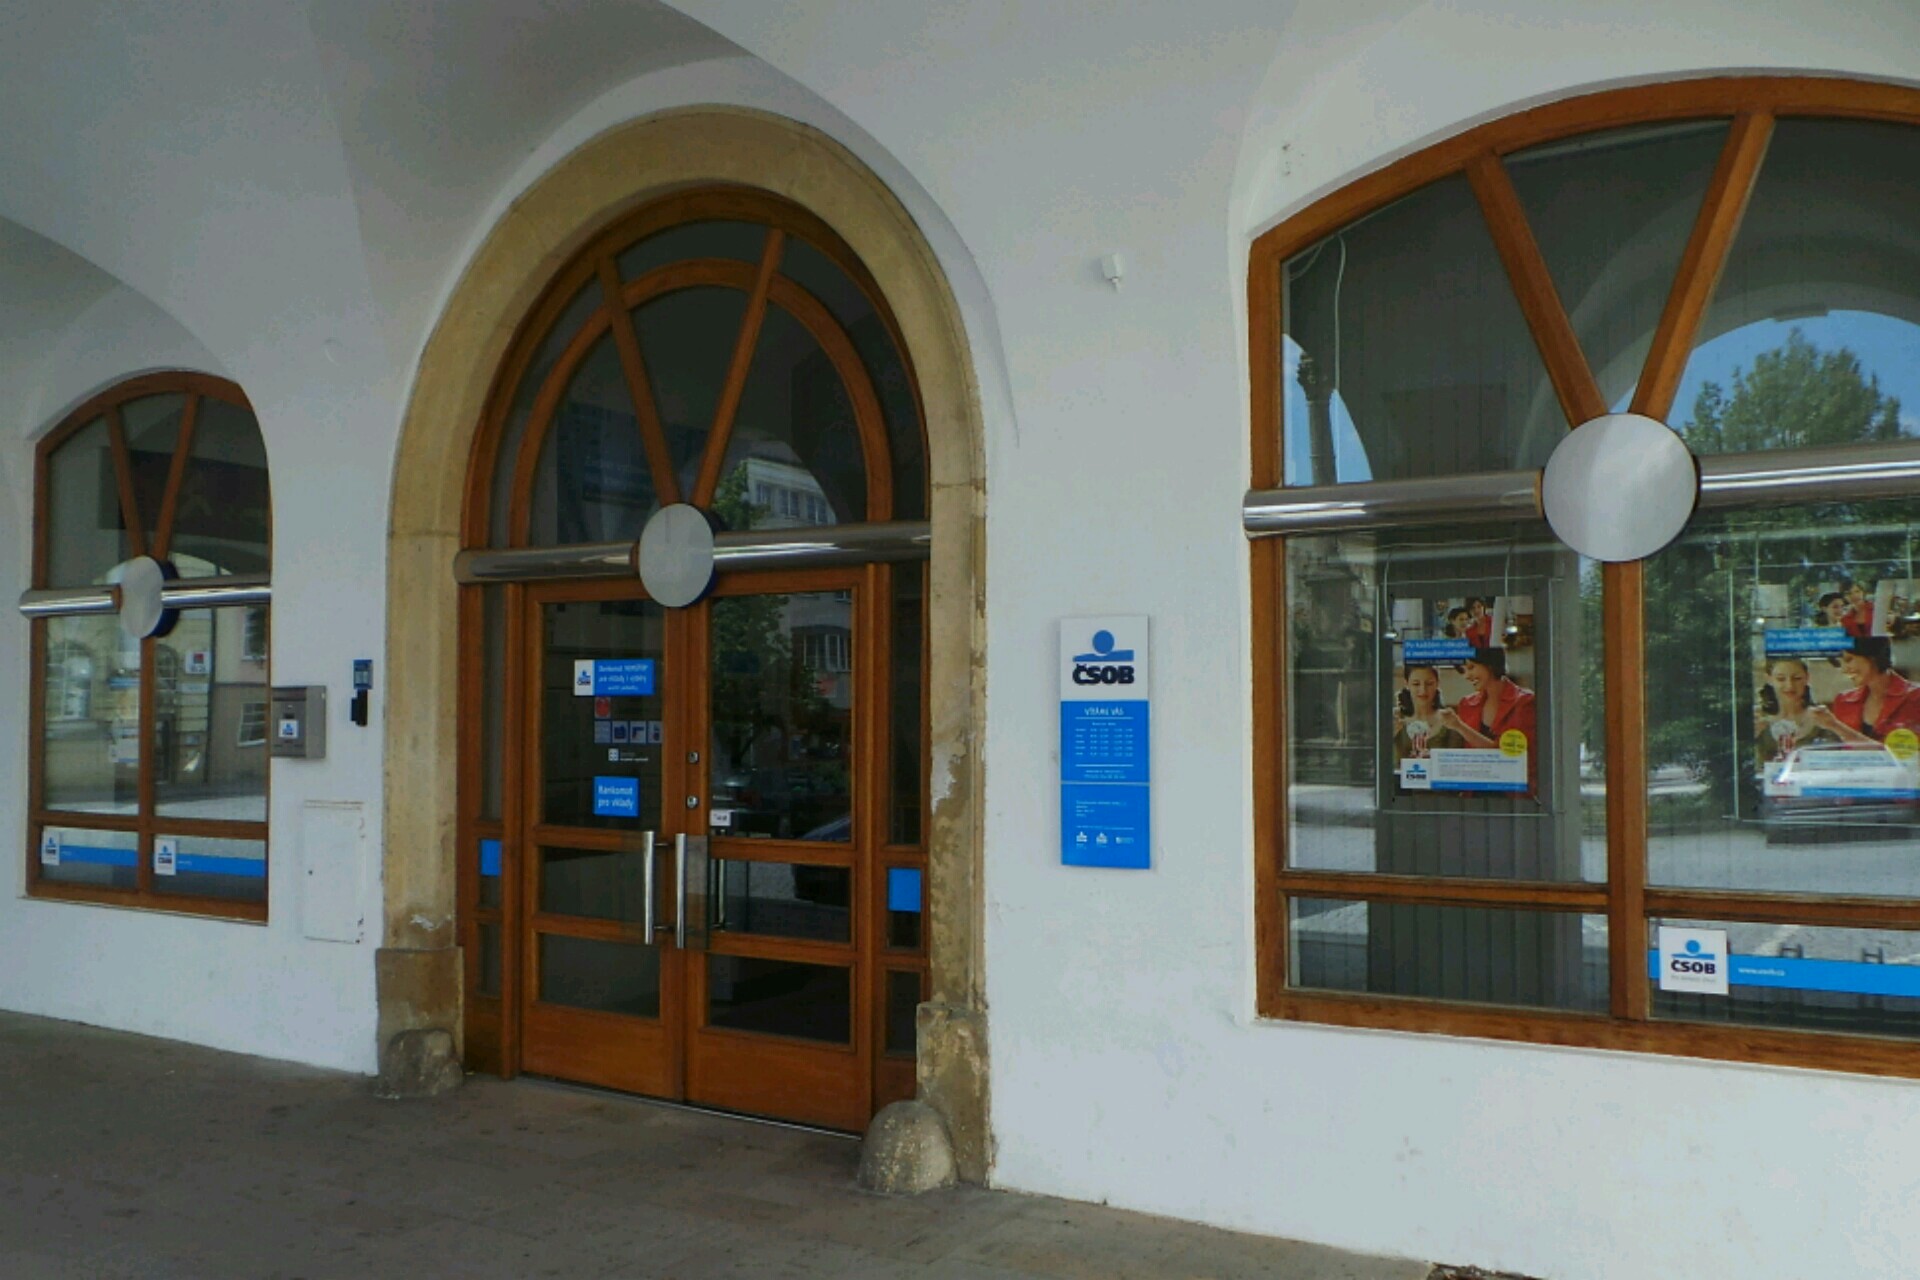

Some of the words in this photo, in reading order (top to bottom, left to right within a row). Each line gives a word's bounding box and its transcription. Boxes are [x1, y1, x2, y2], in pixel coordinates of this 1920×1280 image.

[1072, 664, 1135, 685] ČSOB
[598, 784, 633, 796] Bankomat
[598, 798, 609, 809] pro
[611, 797, 634, 810] vklady
[1671, 959, 1716, 974] ČSOB
